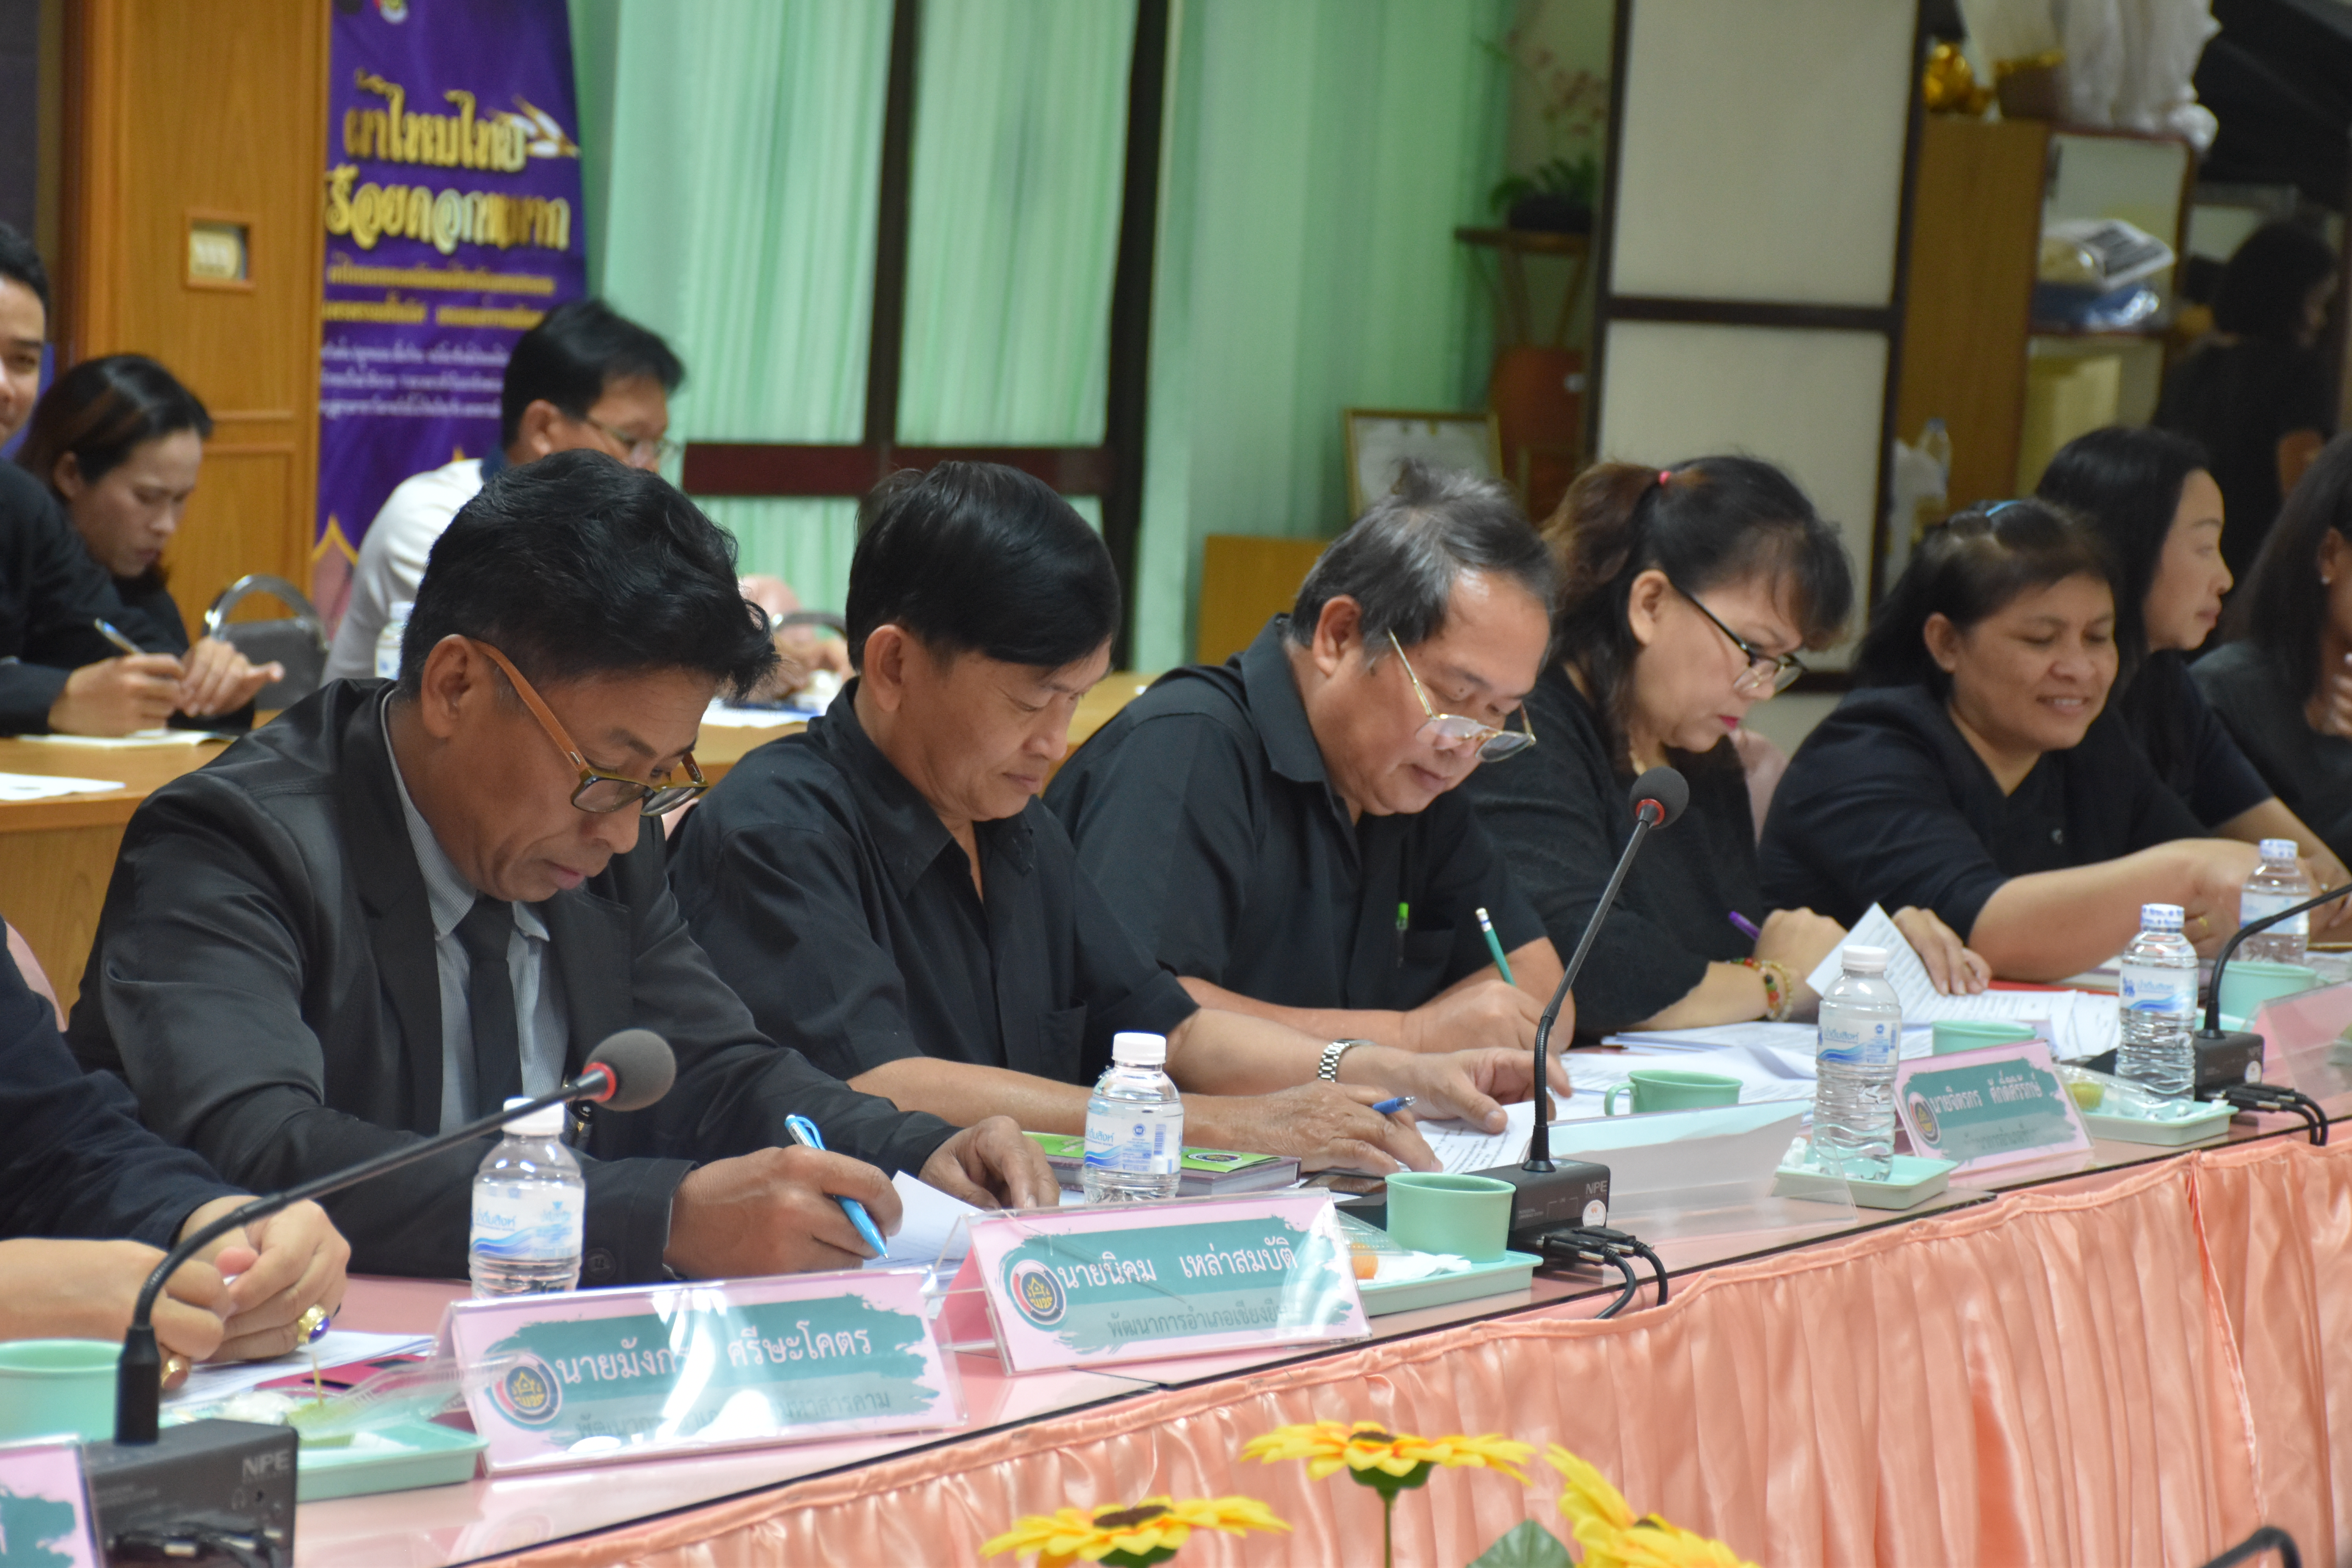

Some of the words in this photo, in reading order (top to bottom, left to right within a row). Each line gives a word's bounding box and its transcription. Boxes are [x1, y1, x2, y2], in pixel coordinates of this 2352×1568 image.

[1586, 1180, 1608, 1194] NPE
[1057, 1251, 1157, 1289] นายนิคม
[1179, 1236, 1298, 1279] เหล่าสมบัติ
[555, 1336, 692, 1385] นายมังก
[727, 1320, 872, 1367] ศรีษะโคตร
[242, 1449, 290, 1477] NPE
